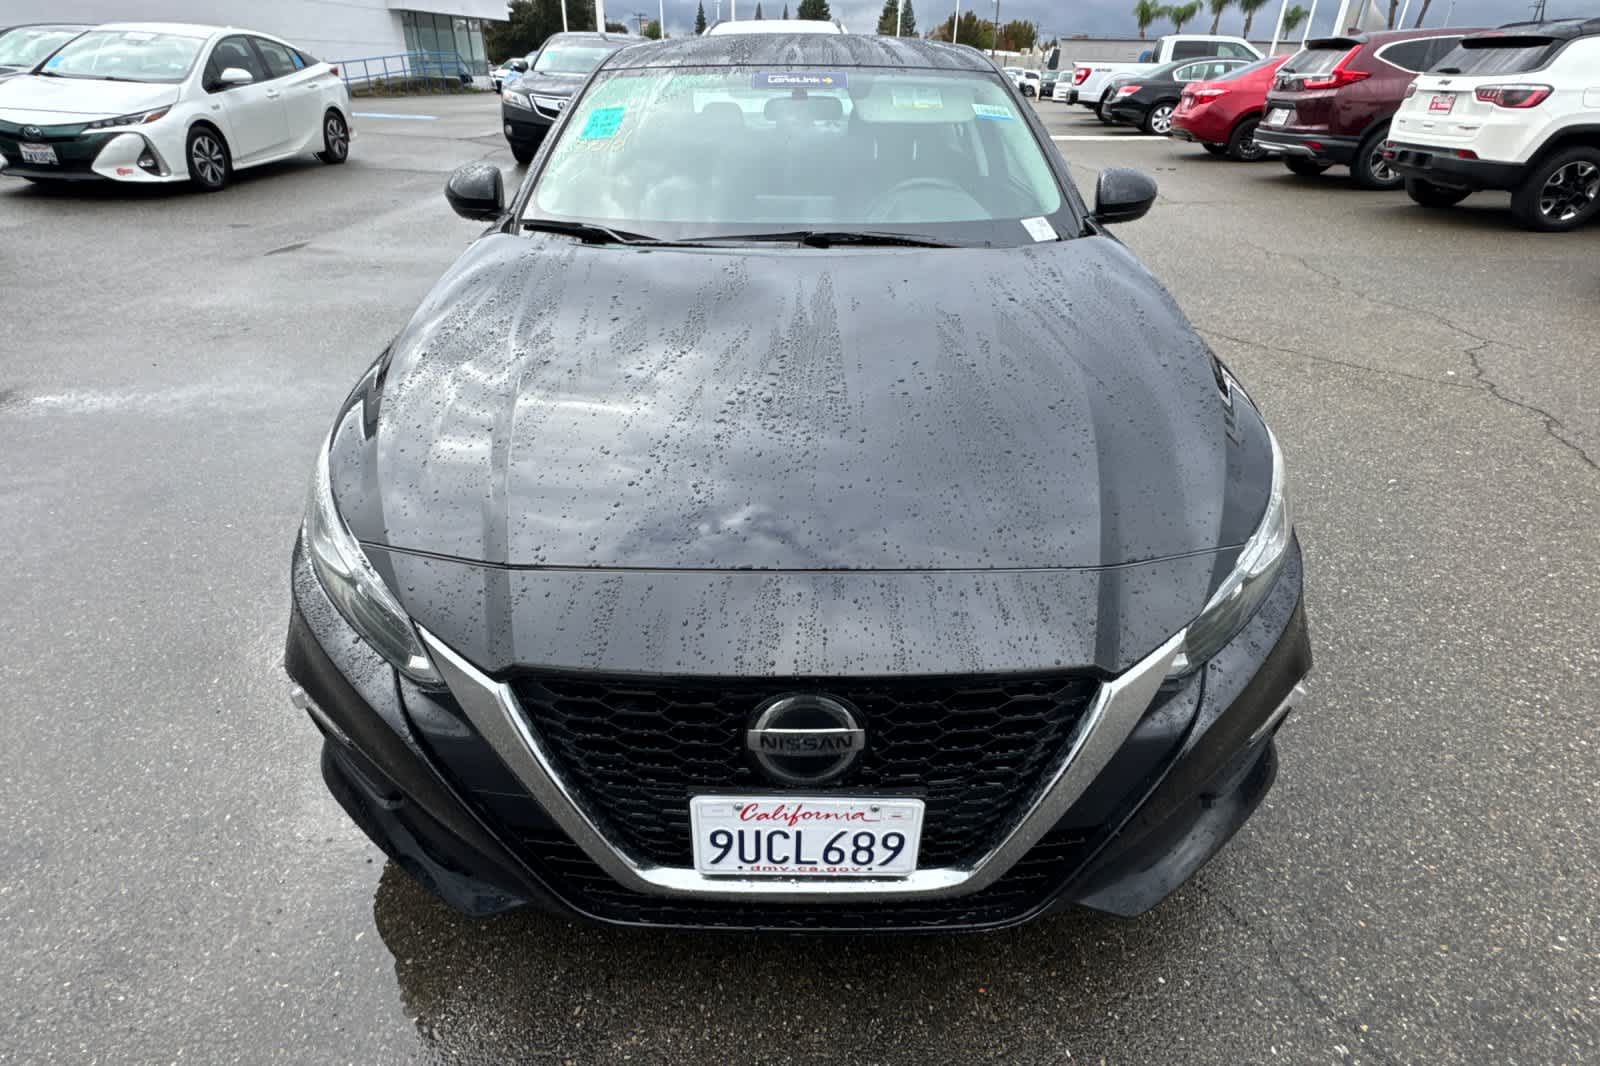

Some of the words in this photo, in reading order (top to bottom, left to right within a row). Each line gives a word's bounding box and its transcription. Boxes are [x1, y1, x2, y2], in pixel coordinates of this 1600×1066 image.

[760, 734, 853, 752] NISSAN
[739, 803, 881, 826] California
[709, 829, 906, 866] 9UCL689
[750, 864, 861, 873] dmv.ca.gov
